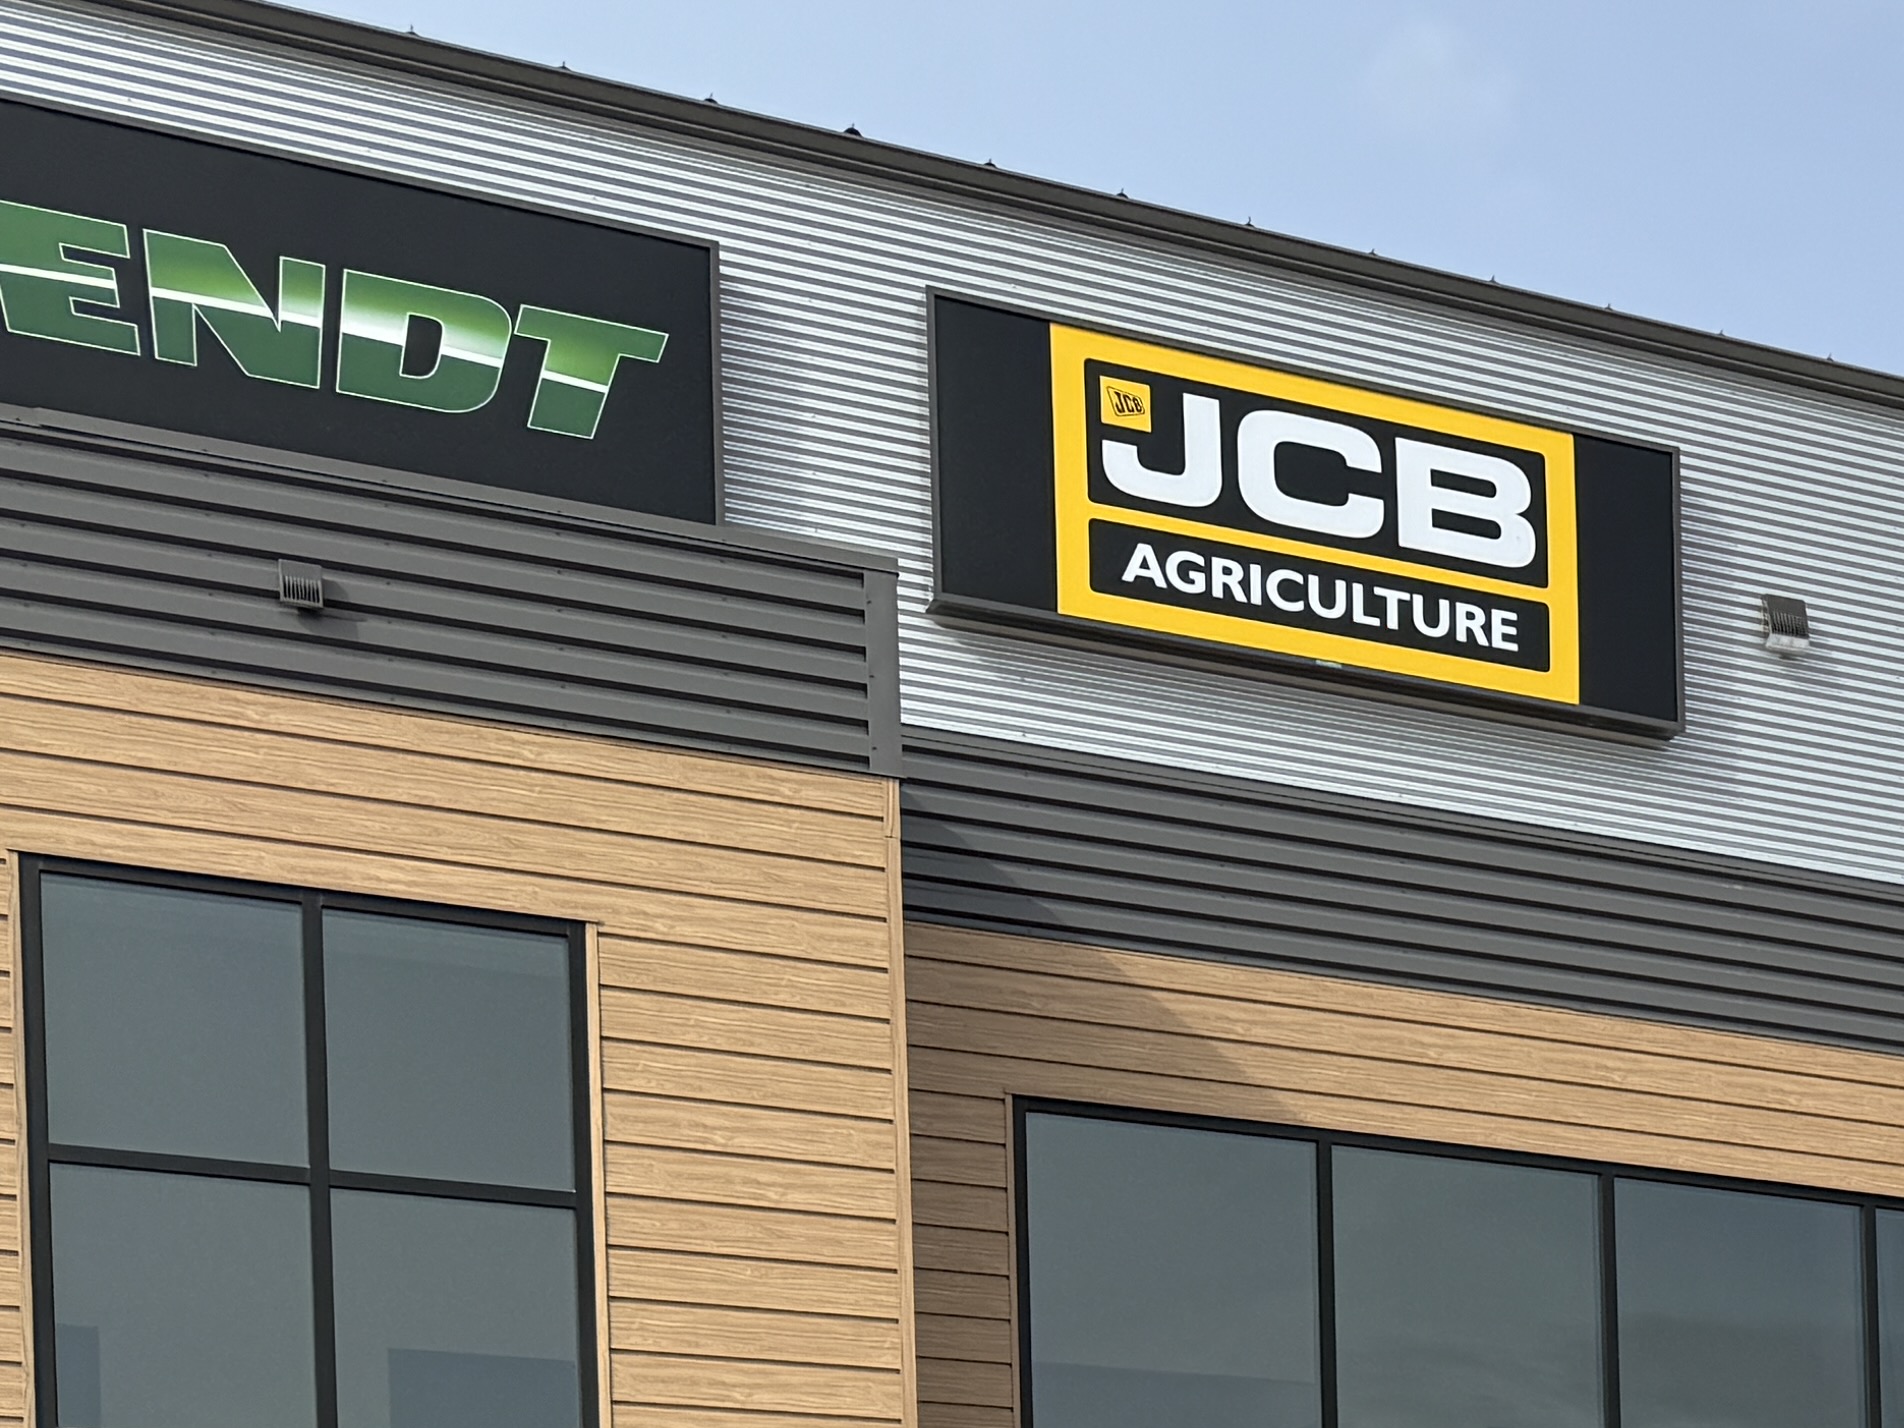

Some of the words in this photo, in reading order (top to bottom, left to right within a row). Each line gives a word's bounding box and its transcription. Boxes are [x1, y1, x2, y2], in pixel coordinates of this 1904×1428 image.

[0, 203, 669, 440] ENDT
[1112, 390, 1143, 414] JCB
[1101, 392, 1537, 569] JCB
[1121, 542, 1520, 653] AGRICULTURE
